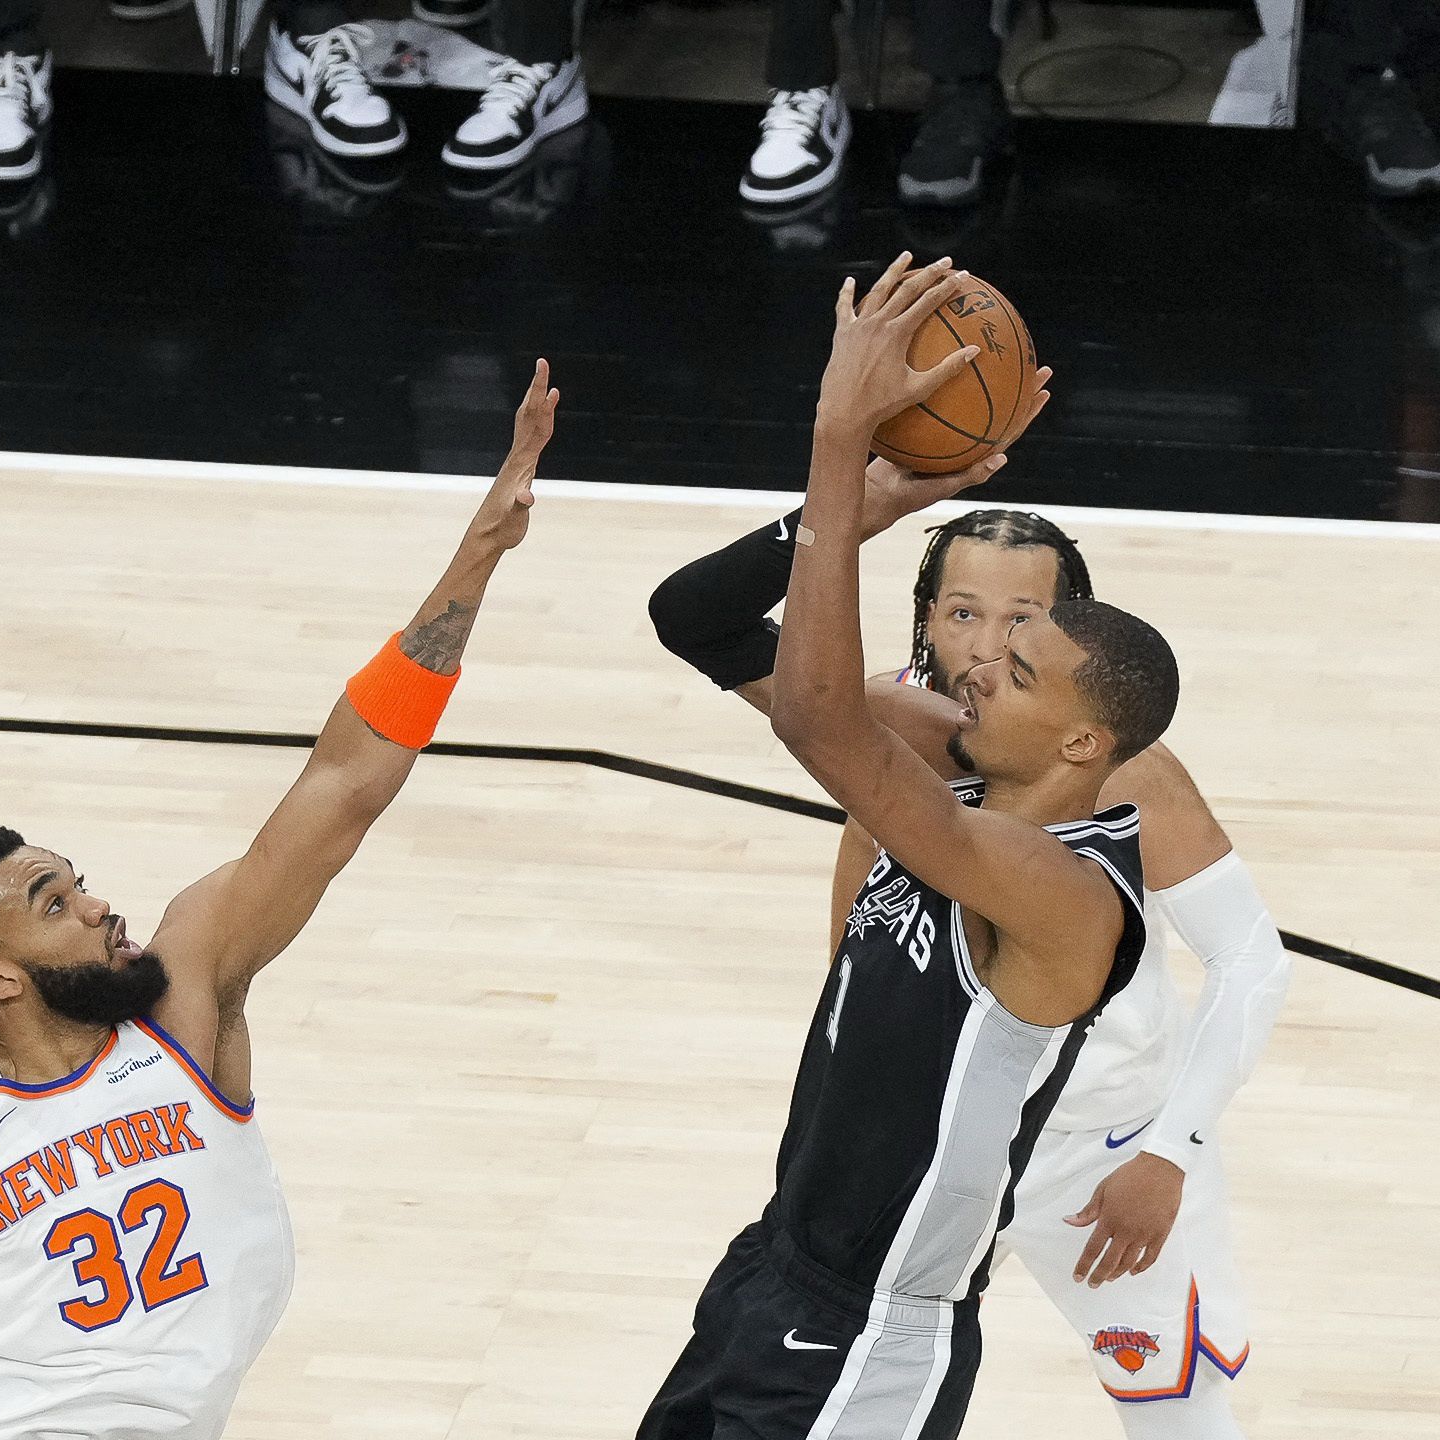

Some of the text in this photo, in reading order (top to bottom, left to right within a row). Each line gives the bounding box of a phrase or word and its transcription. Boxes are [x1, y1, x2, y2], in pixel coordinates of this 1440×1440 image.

[846, 848, 936, 974] PURS
[825, 952, 853, 1055] 1
[107, 1069, 129, 1085] abu
[129, 1050, 163, 1072] dhabi
[73, 1101, 206, 1179] YORK
[42, 1177, 210, 1333] 32
